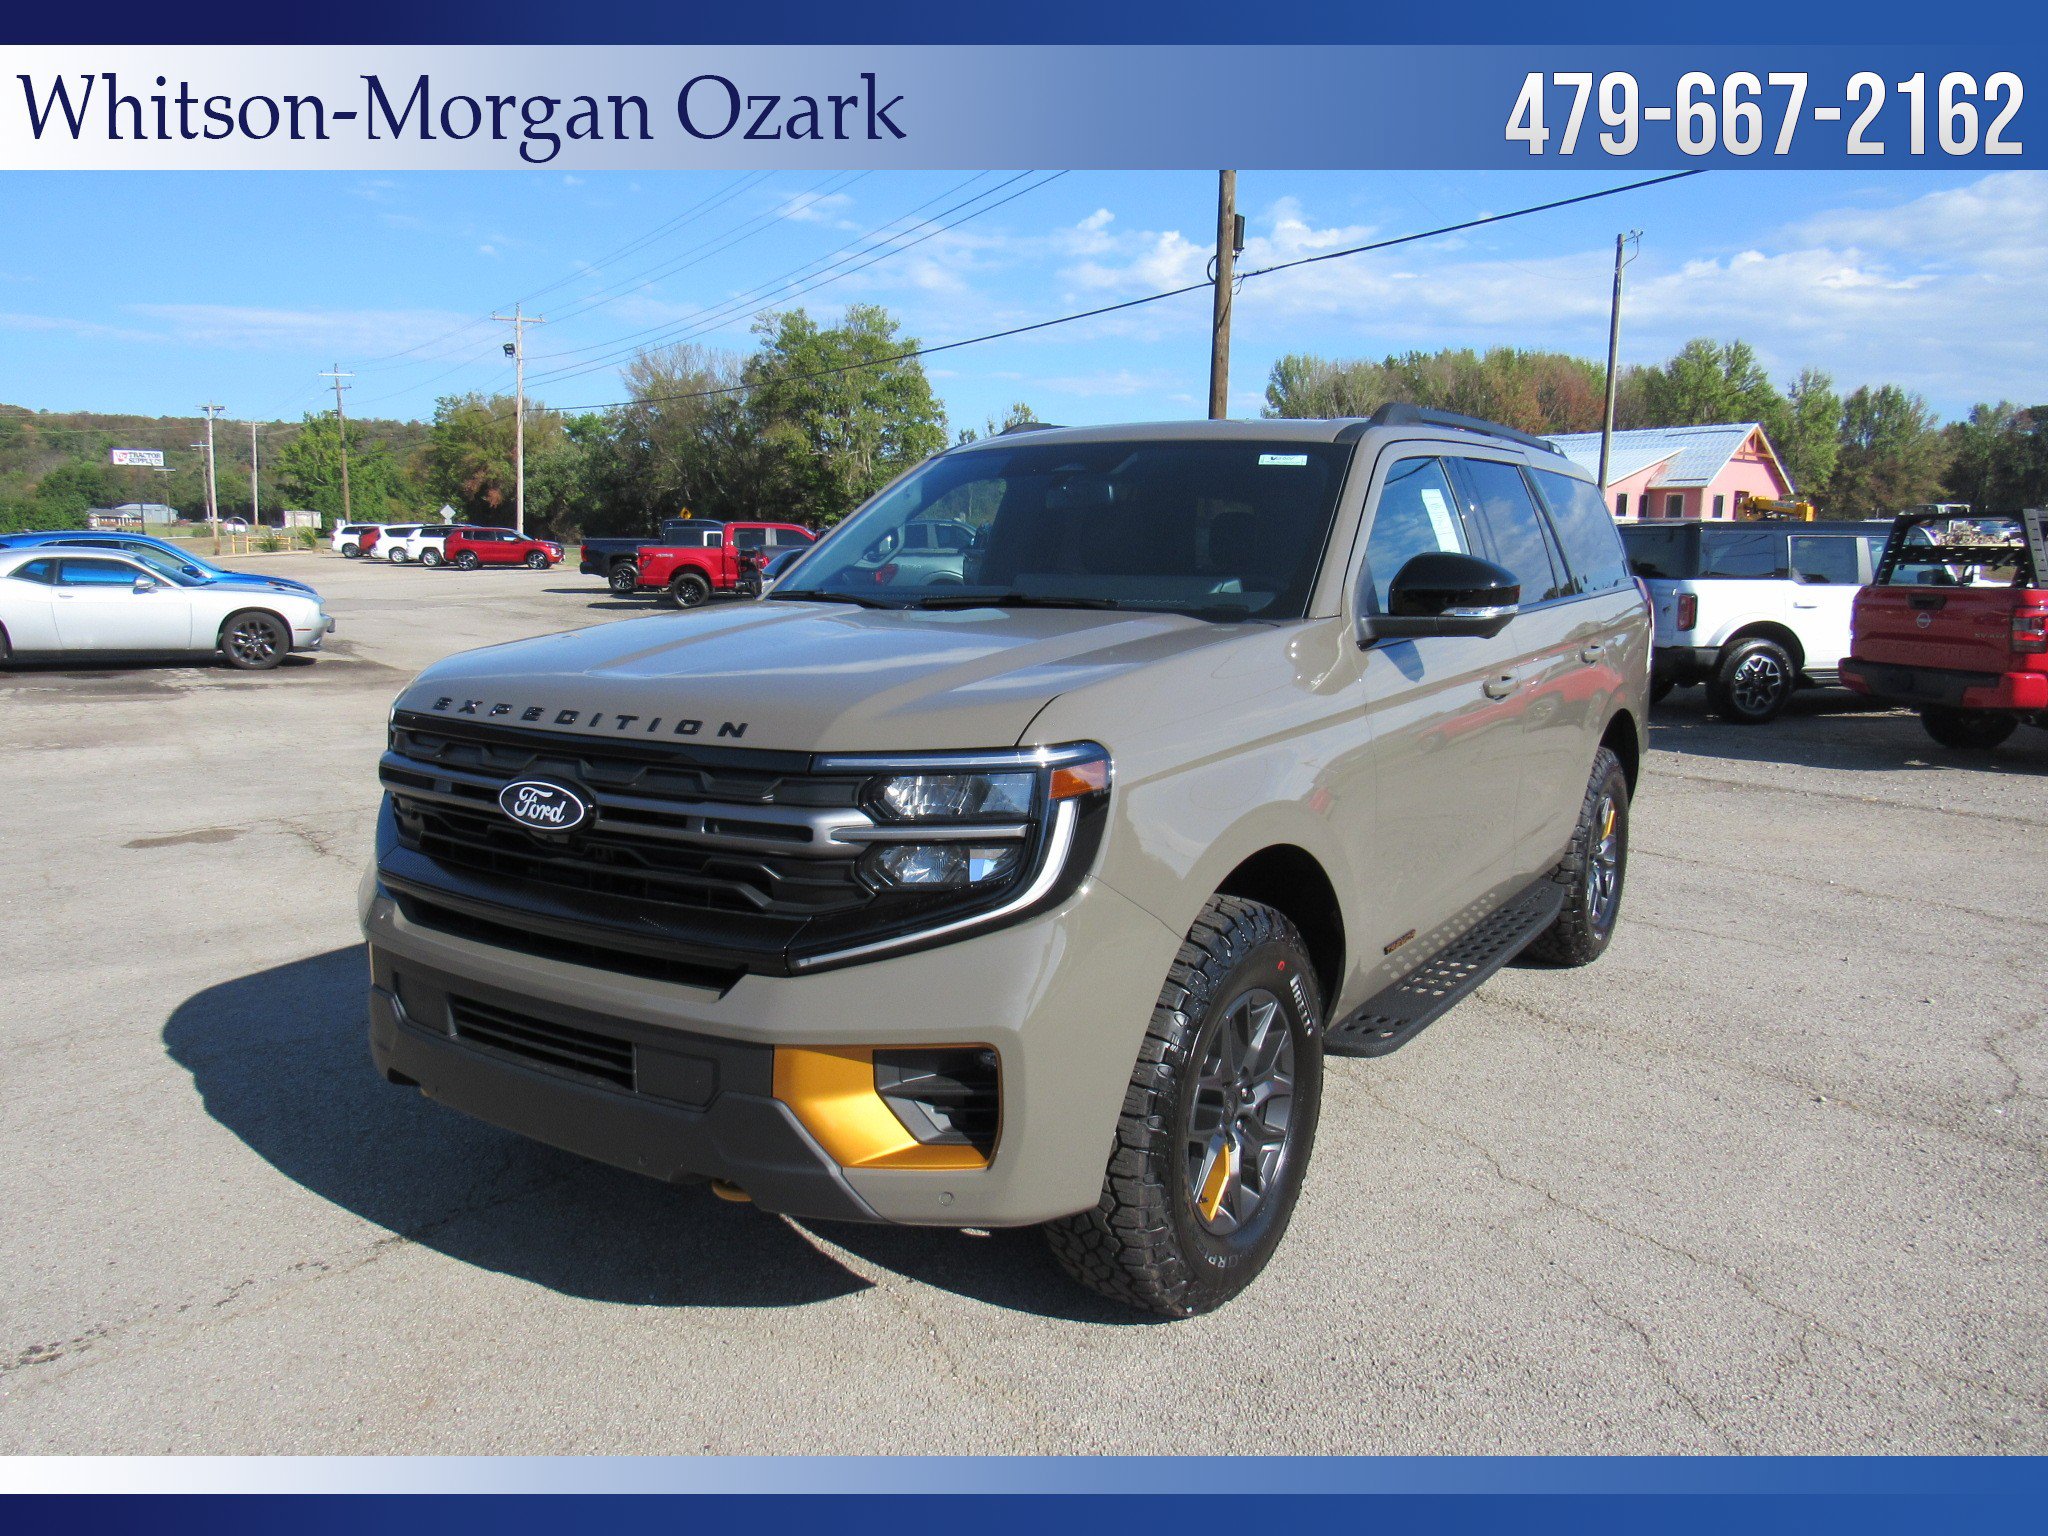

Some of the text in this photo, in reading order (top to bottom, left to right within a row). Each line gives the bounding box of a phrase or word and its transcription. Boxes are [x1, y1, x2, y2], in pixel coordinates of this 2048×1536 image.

[128, 451, 162, 459] TRACTOR
[432, 696, 750, 739] EXPEDITION
[514, 786, 567, 824] Ford
